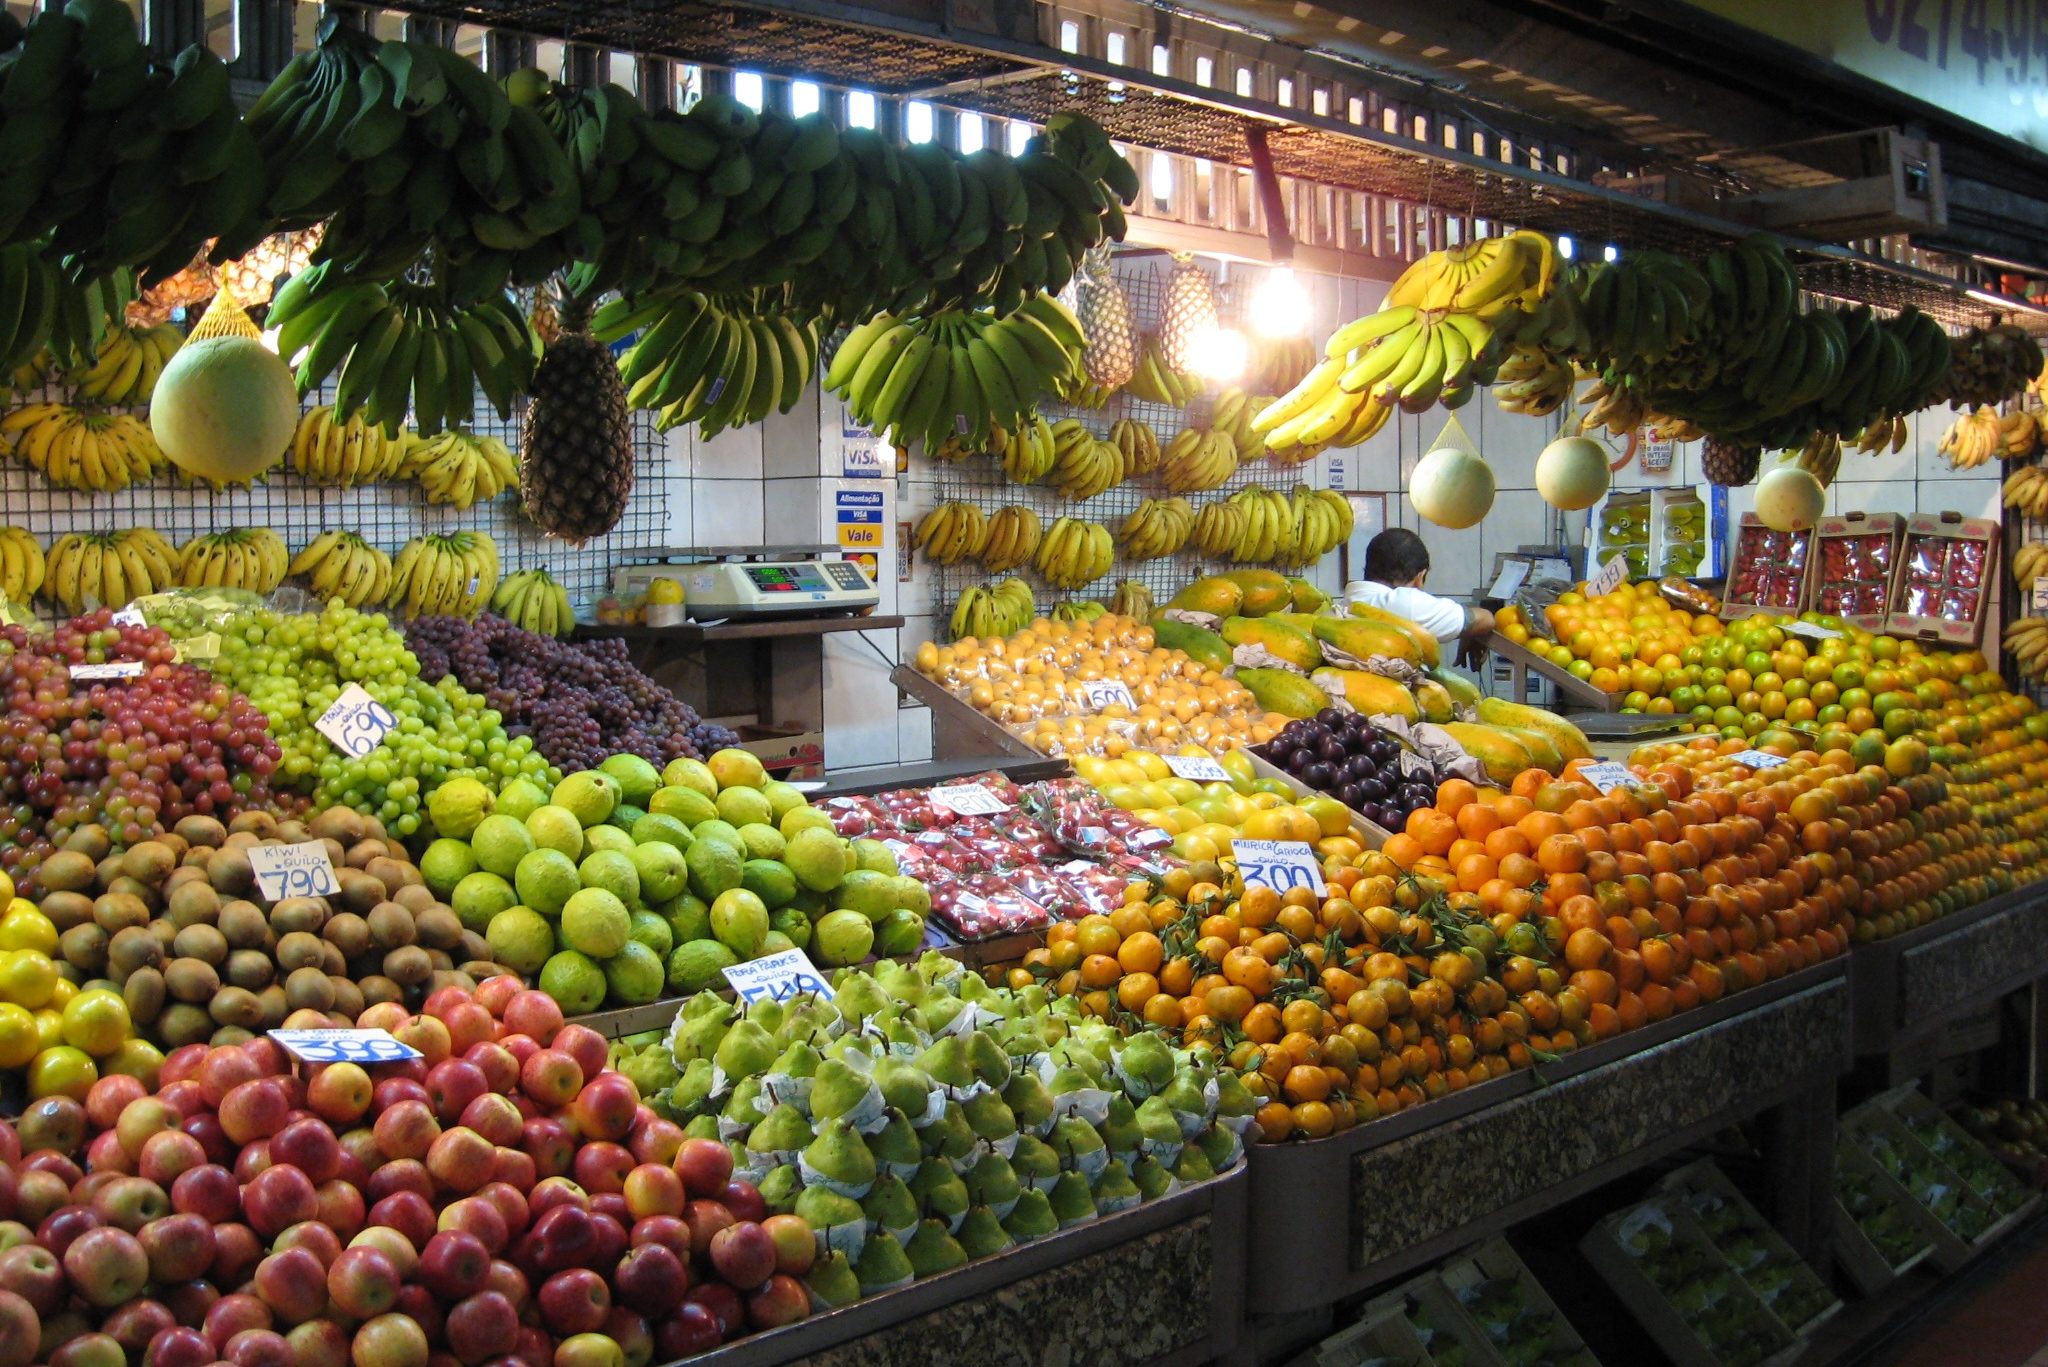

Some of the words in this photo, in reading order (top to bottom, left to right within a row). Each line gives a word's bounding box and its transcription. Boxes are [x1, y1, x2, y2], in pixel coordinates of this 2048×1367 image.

[849, 449, 880, 465] VISA
[840, 493, 880, 504] Alimentação
[853, 510, 868, 518] VISA
[847, 529, 873, 541] Vale
[264, 845, 301, 858] KIWI
